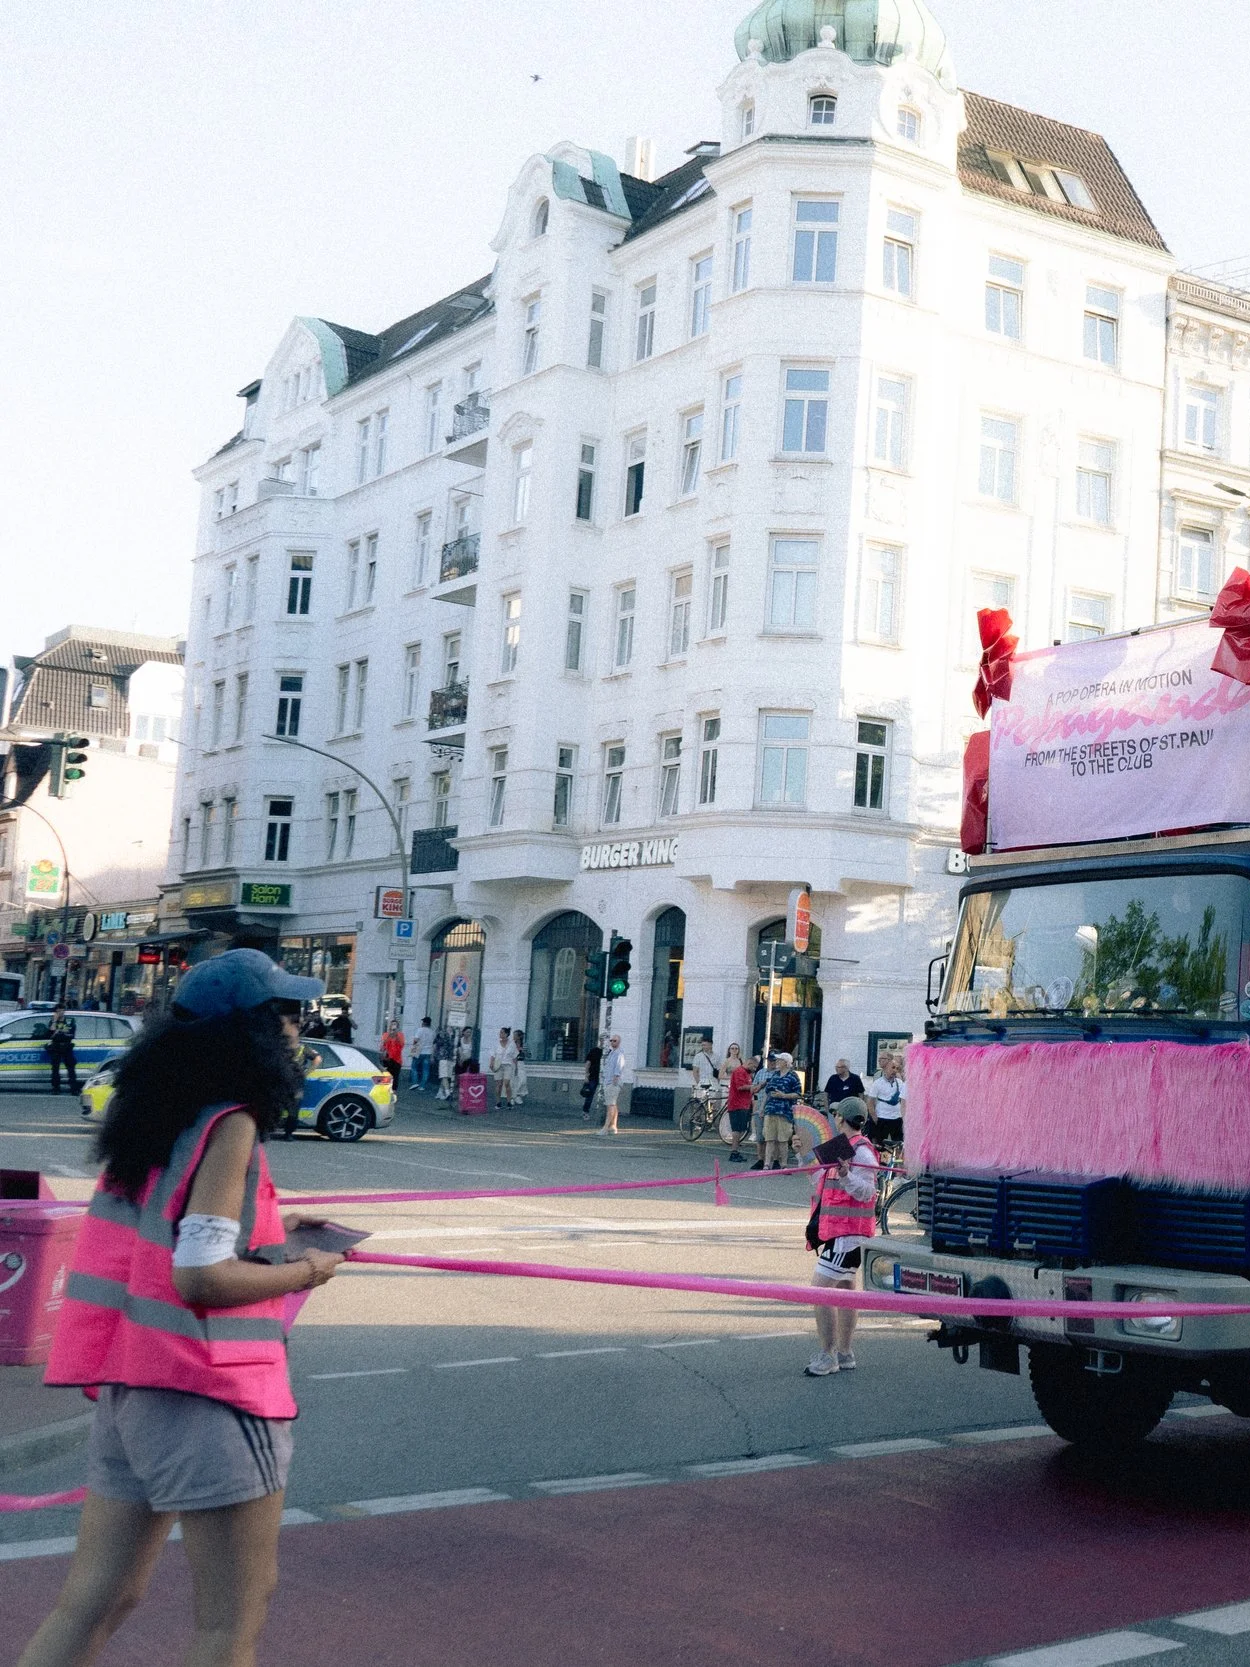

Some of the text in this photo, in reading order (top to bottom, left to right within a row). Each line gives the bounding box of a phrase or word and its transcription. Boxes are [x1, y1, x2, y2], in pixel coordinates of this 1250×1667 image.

[1047, 668, 1193, 706] A POP OPERA IN MOTION
[1025, 749, 1056, 767] FROM
[1058, 745, 1078, 763] THE
[1079, 739, 1137, 760] STREETS
[1139, 736, 1159, 753] OF
[1070, 752, 1153, 777] TO THE CLUB
[580, 838, 679, 869] BURGER KING
[251, 884, 281, 894] Salon
[251, 893, 280, 905] Harry
[399, 923, 410, 935] P
[0, 1053, 41, 1062] POLIZEI
